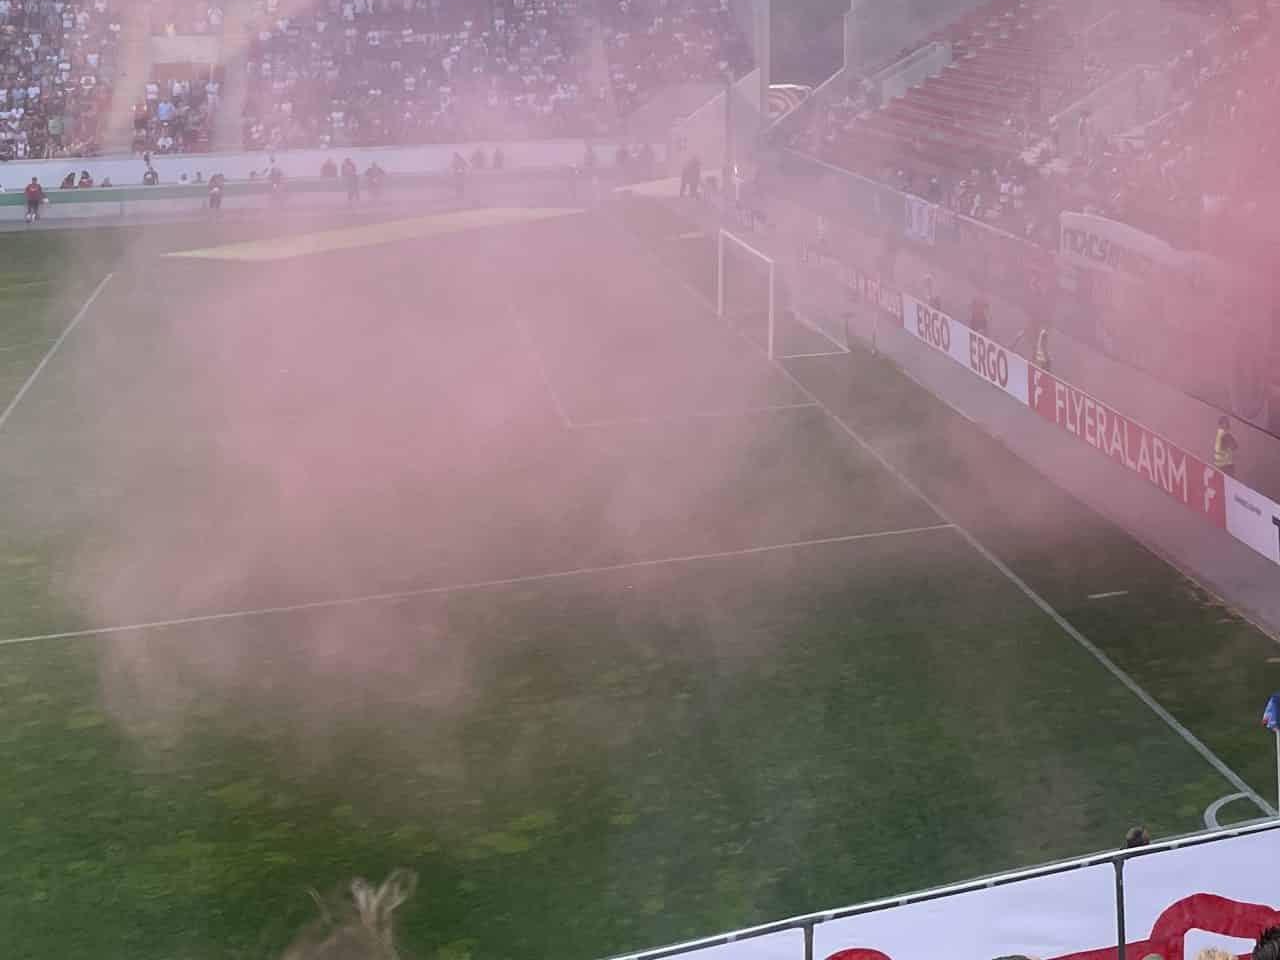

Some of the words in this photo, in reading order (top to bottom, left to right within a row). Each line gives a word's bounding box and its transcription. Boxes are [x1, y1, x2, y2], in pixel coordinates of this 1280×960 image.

[916, 304, 951, 353] ERGO
[969, 330, 1009, 389] ERGO
[1055, 381, 1188, 503] FLYERALARM
